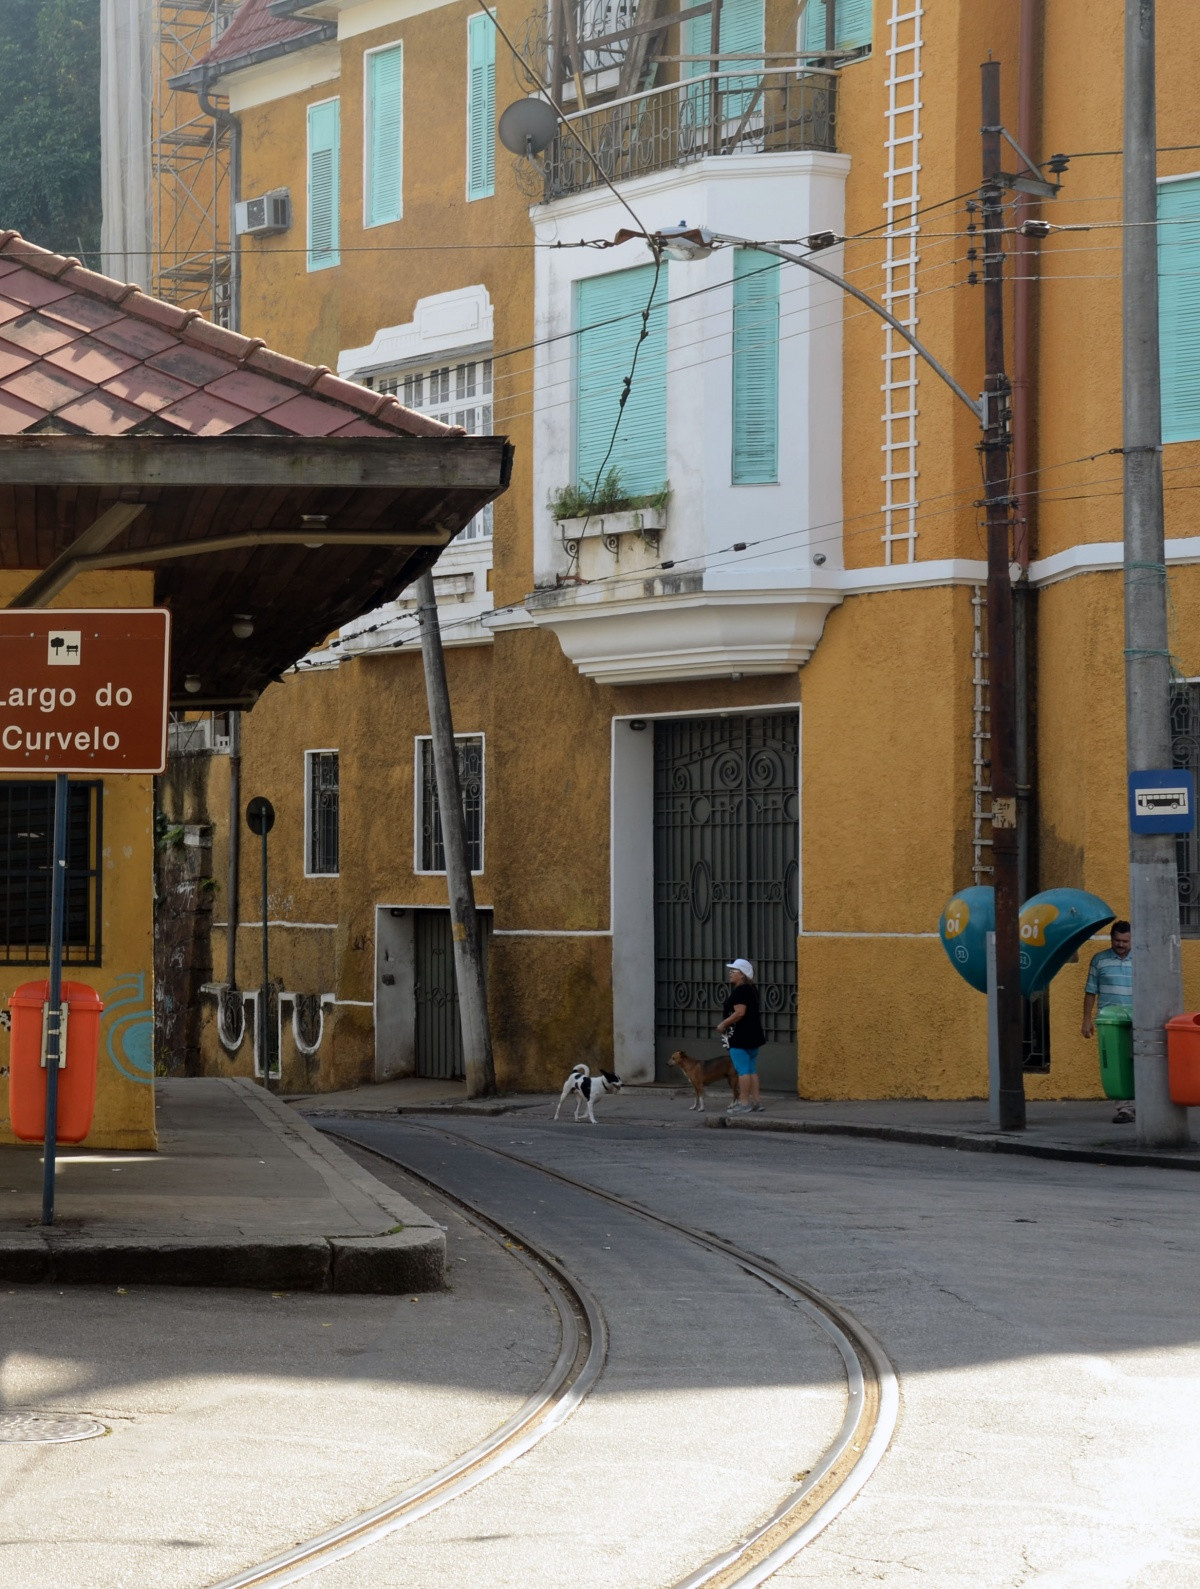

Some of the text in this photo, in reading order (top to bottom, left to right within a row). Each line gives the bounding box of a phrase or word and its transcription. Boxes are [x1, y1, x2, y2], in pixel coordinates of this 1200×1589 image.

[95, 682, 133, 707] do
[1, 725, 120, 751] Curvelo
[946, 913, 961, 933] oi
[1020, 918, 1040, 939] oi
